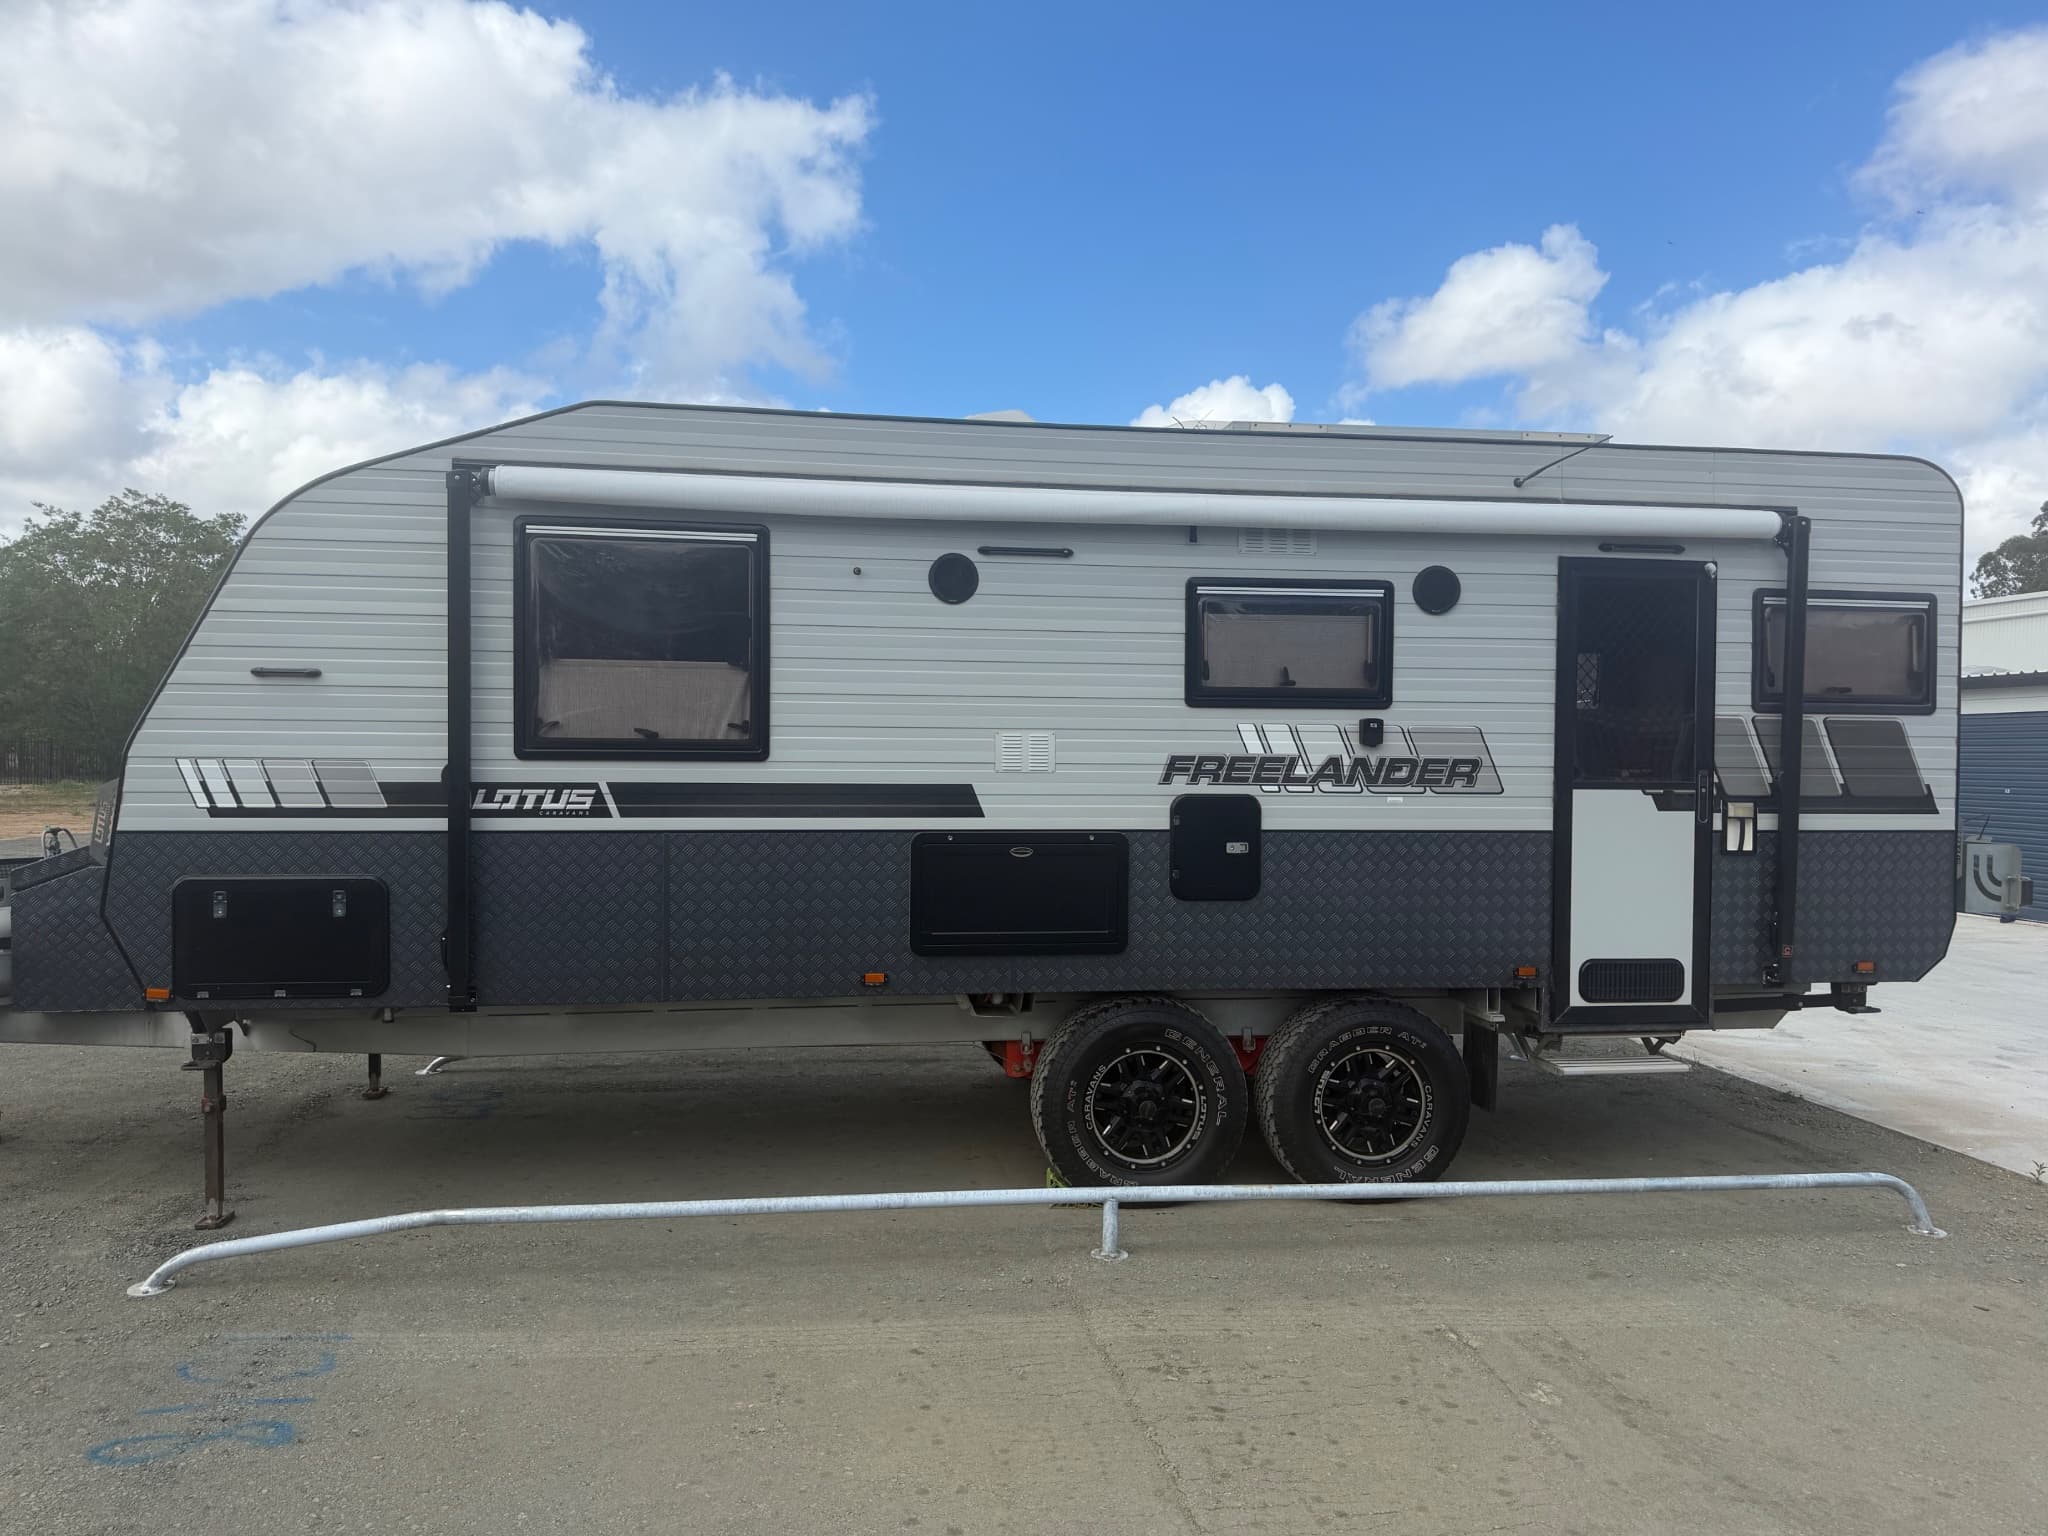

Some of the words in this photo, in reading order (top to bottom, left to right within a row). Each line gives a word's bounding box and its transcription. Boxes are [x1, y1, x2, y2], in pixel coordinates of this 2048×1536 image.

[1158, 754, 1483, 787] FREELANDER
[471, 789, 597, 810] LOTUS
[1308, 1026, 1393, 1074] GRABBER
[1084, 1064, 1107, 1130] CARAVANS
[1164, 1028, 1227, 1127] GENERAL
[1313, 1069, 1331, 1115] LOTUS
[1191, 1095, 1208, 1141] LOTUS
[1410, 1085, 1434, 1149] CARAVANS
